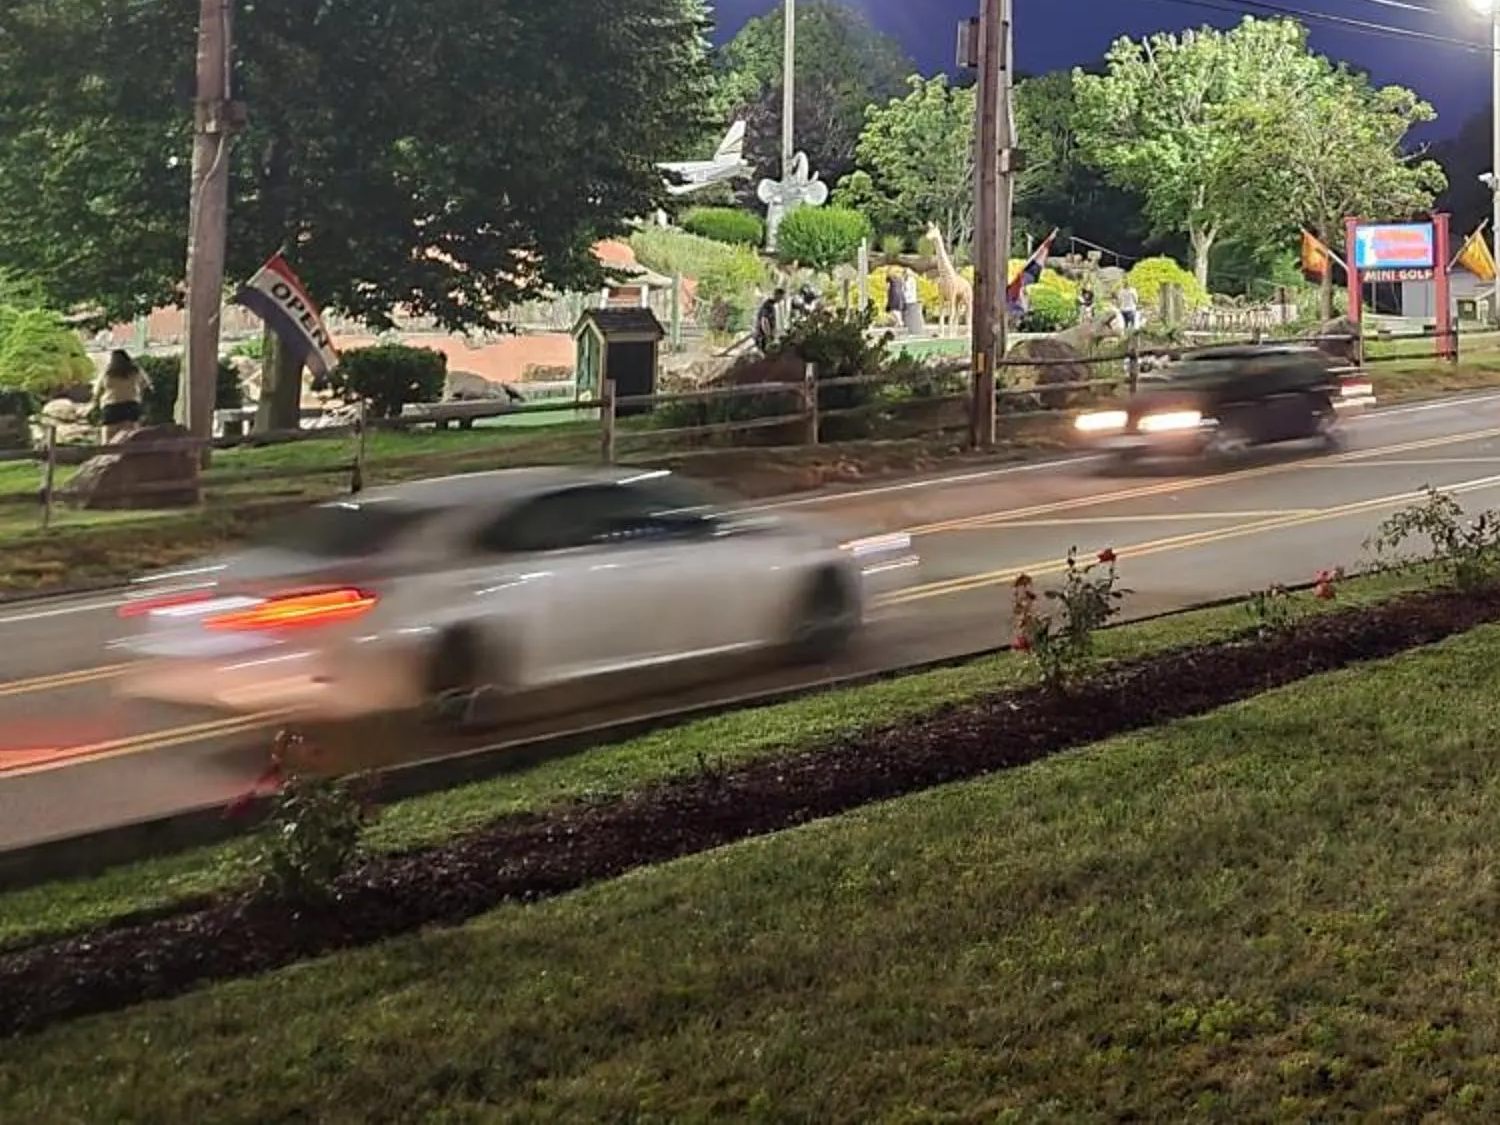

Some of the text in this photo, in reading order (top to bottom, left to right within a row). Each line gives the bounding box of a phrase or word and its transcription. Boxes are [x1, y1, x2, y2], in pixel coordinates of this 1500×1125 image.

[1363, 269, 1433, 282] MINI GOLF
[271, 282, 329, 349] OPEN
